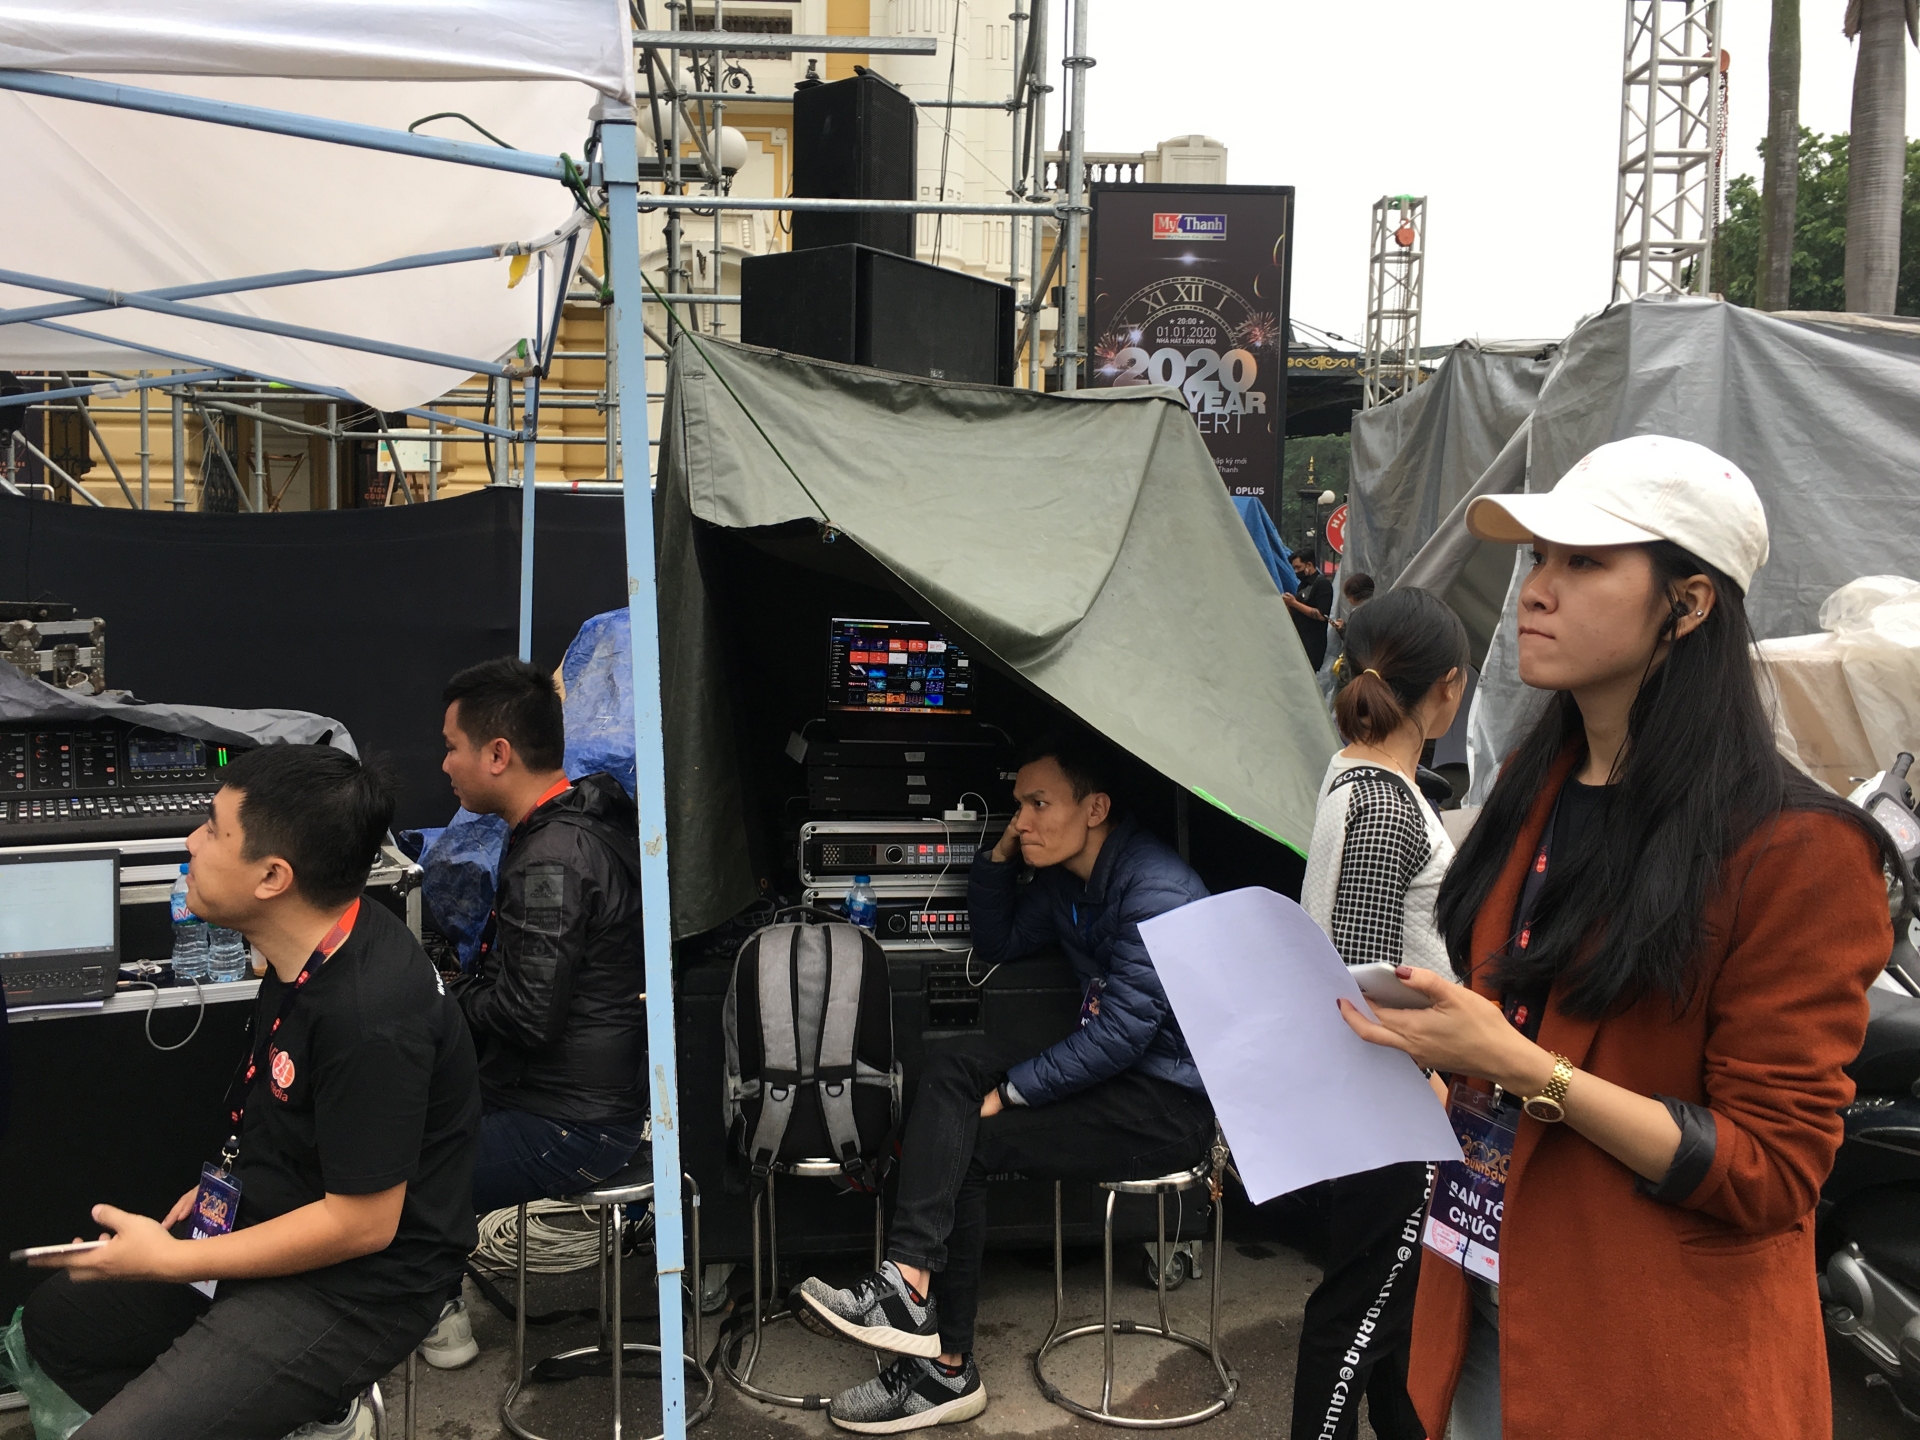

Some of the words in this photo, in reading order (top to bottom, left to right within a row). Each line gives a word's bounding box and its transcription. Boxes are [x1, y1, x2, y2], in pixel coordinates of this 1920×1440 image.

[1183, 217, 1223, 231] Thanh
[1140, 289, 1168, 315] XI
[1174, 283, 1203, 302] XII
[1156, 326, 1217, 338] 01.01.2020
[1177, 317, 1197, 325] 20:00
[1113, 348, 1257, 393] 2020
[1184, 391, 1267, 414] YEAR
[1236, 487, 1264, 495] OPLUS
[1335, 769, 1380, 786] SONY
[1461, 1134, 1511, 1176] 2020
[1464, 1157, 1507, 1184] OUNTDOW
[203, 1192, 228, 1219] 2020
[1449, 1180, 1481, 1210] BAN
[1449, 1206, 1497, 1242] CHỨC
